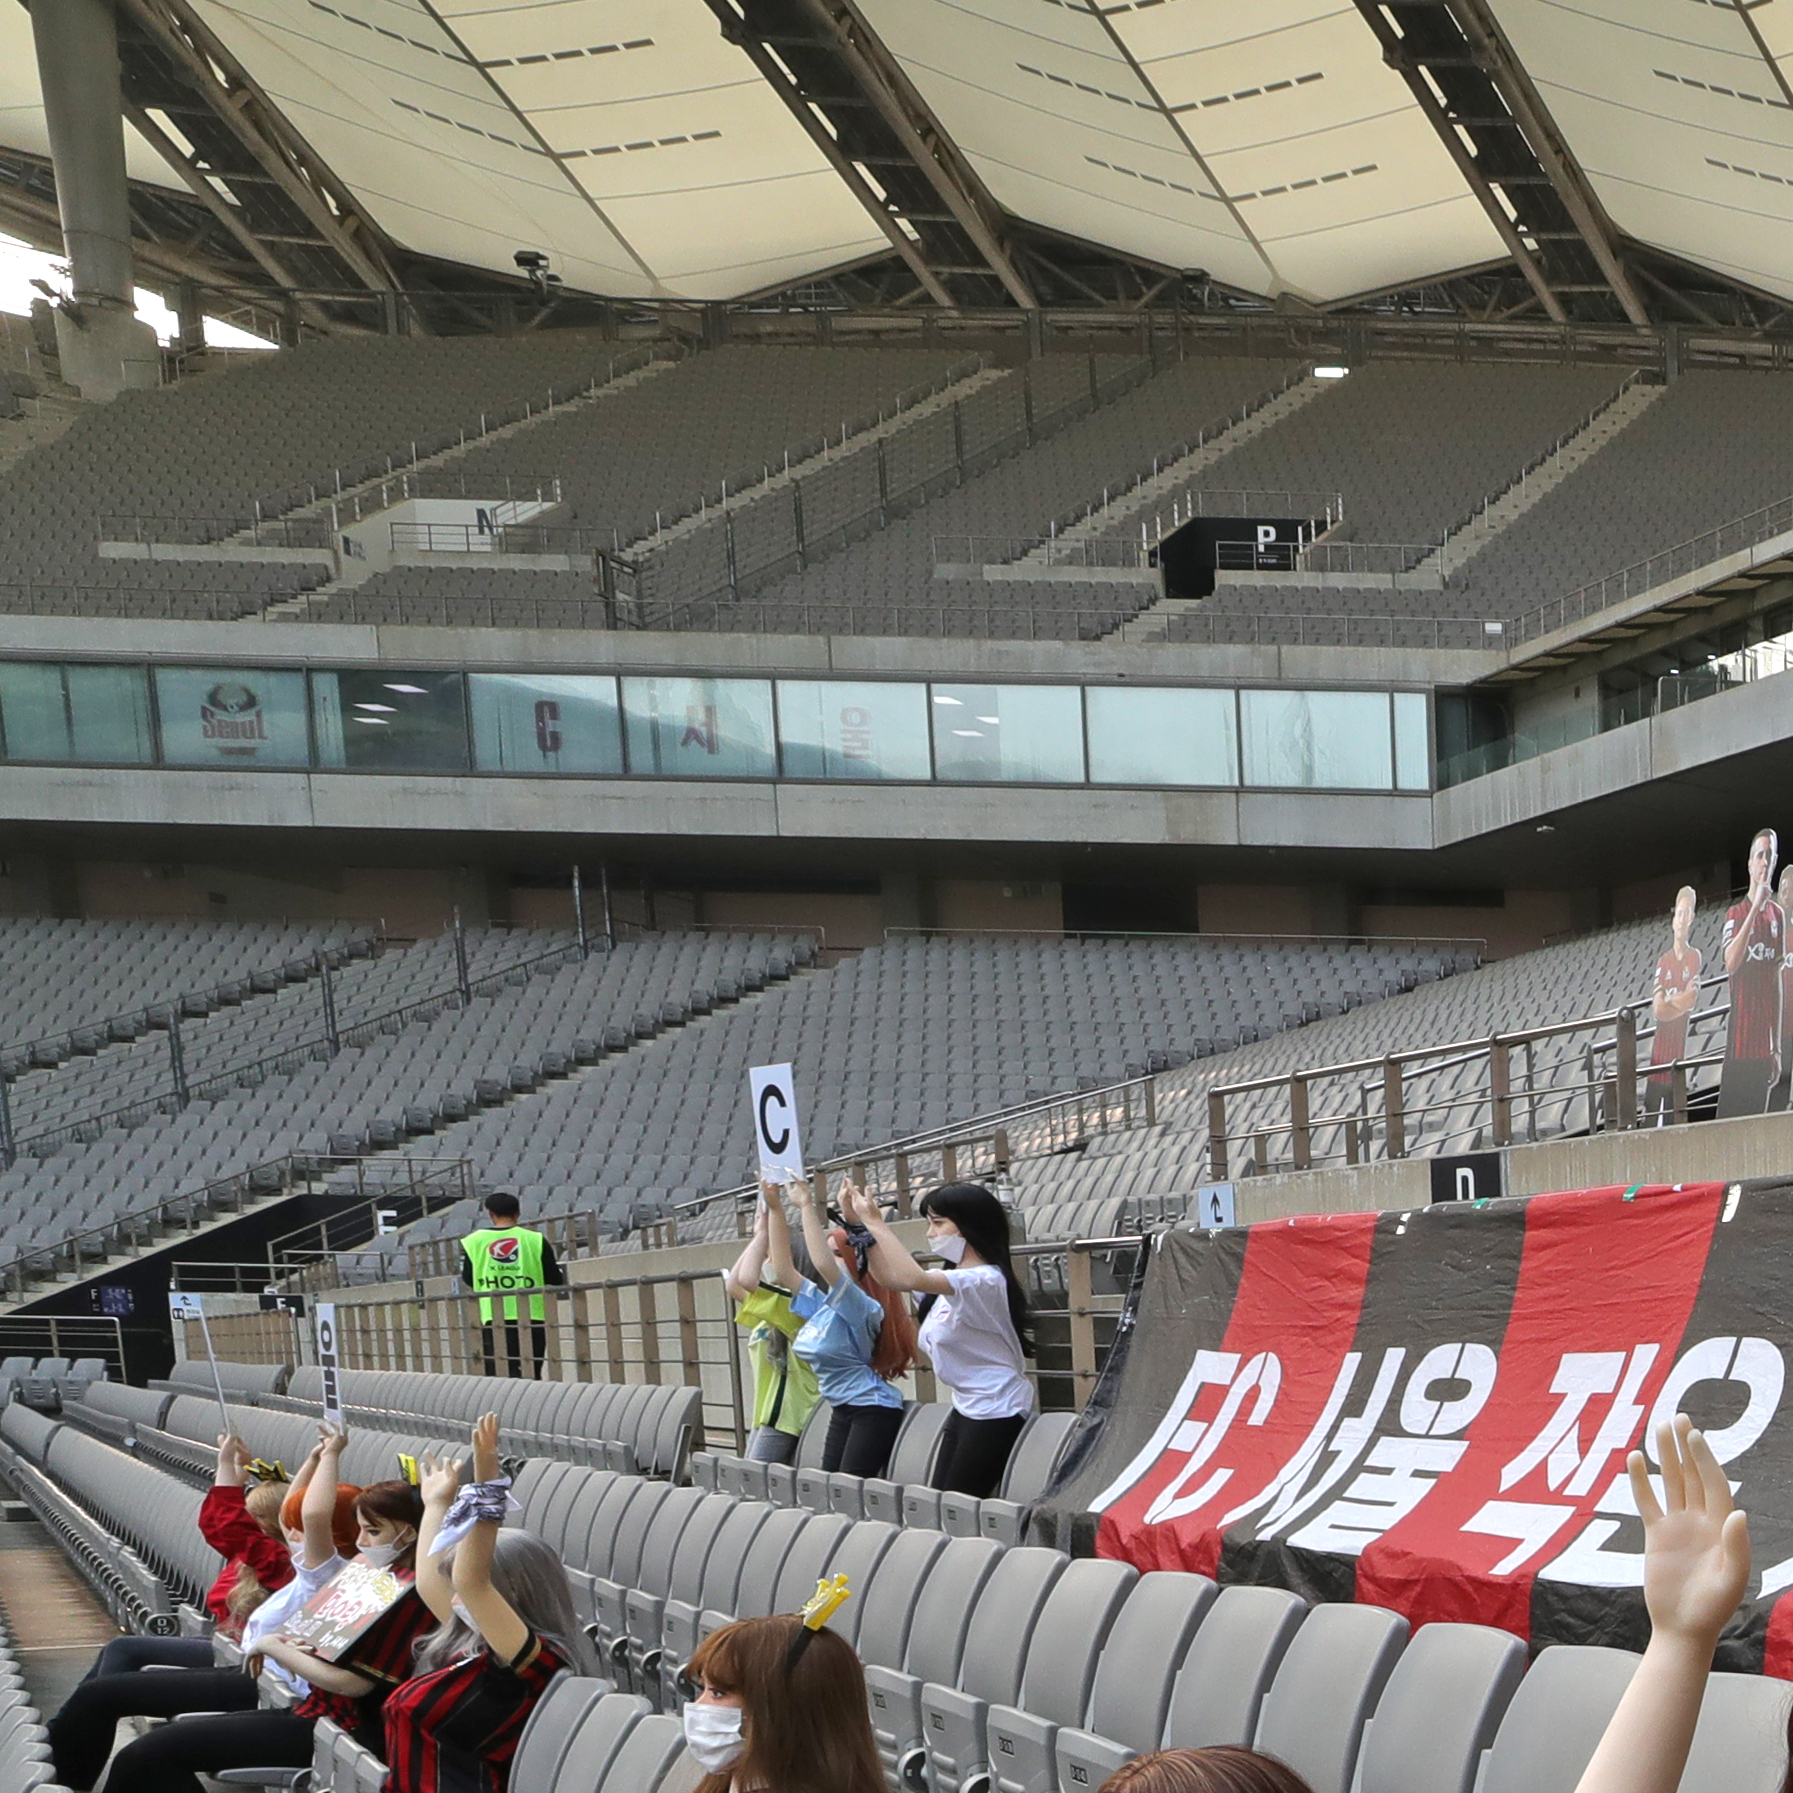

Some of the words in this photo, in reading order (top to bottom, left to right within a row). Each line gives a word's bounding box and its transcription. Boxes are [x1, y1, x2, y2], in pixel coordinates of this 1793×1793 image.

[1256, 525, 1277, 553] P
[200, 703, 269, 740] Seoul
[757, 1083, 790, 1157] C
[1458, 1335, 1787, 1590] 작은
